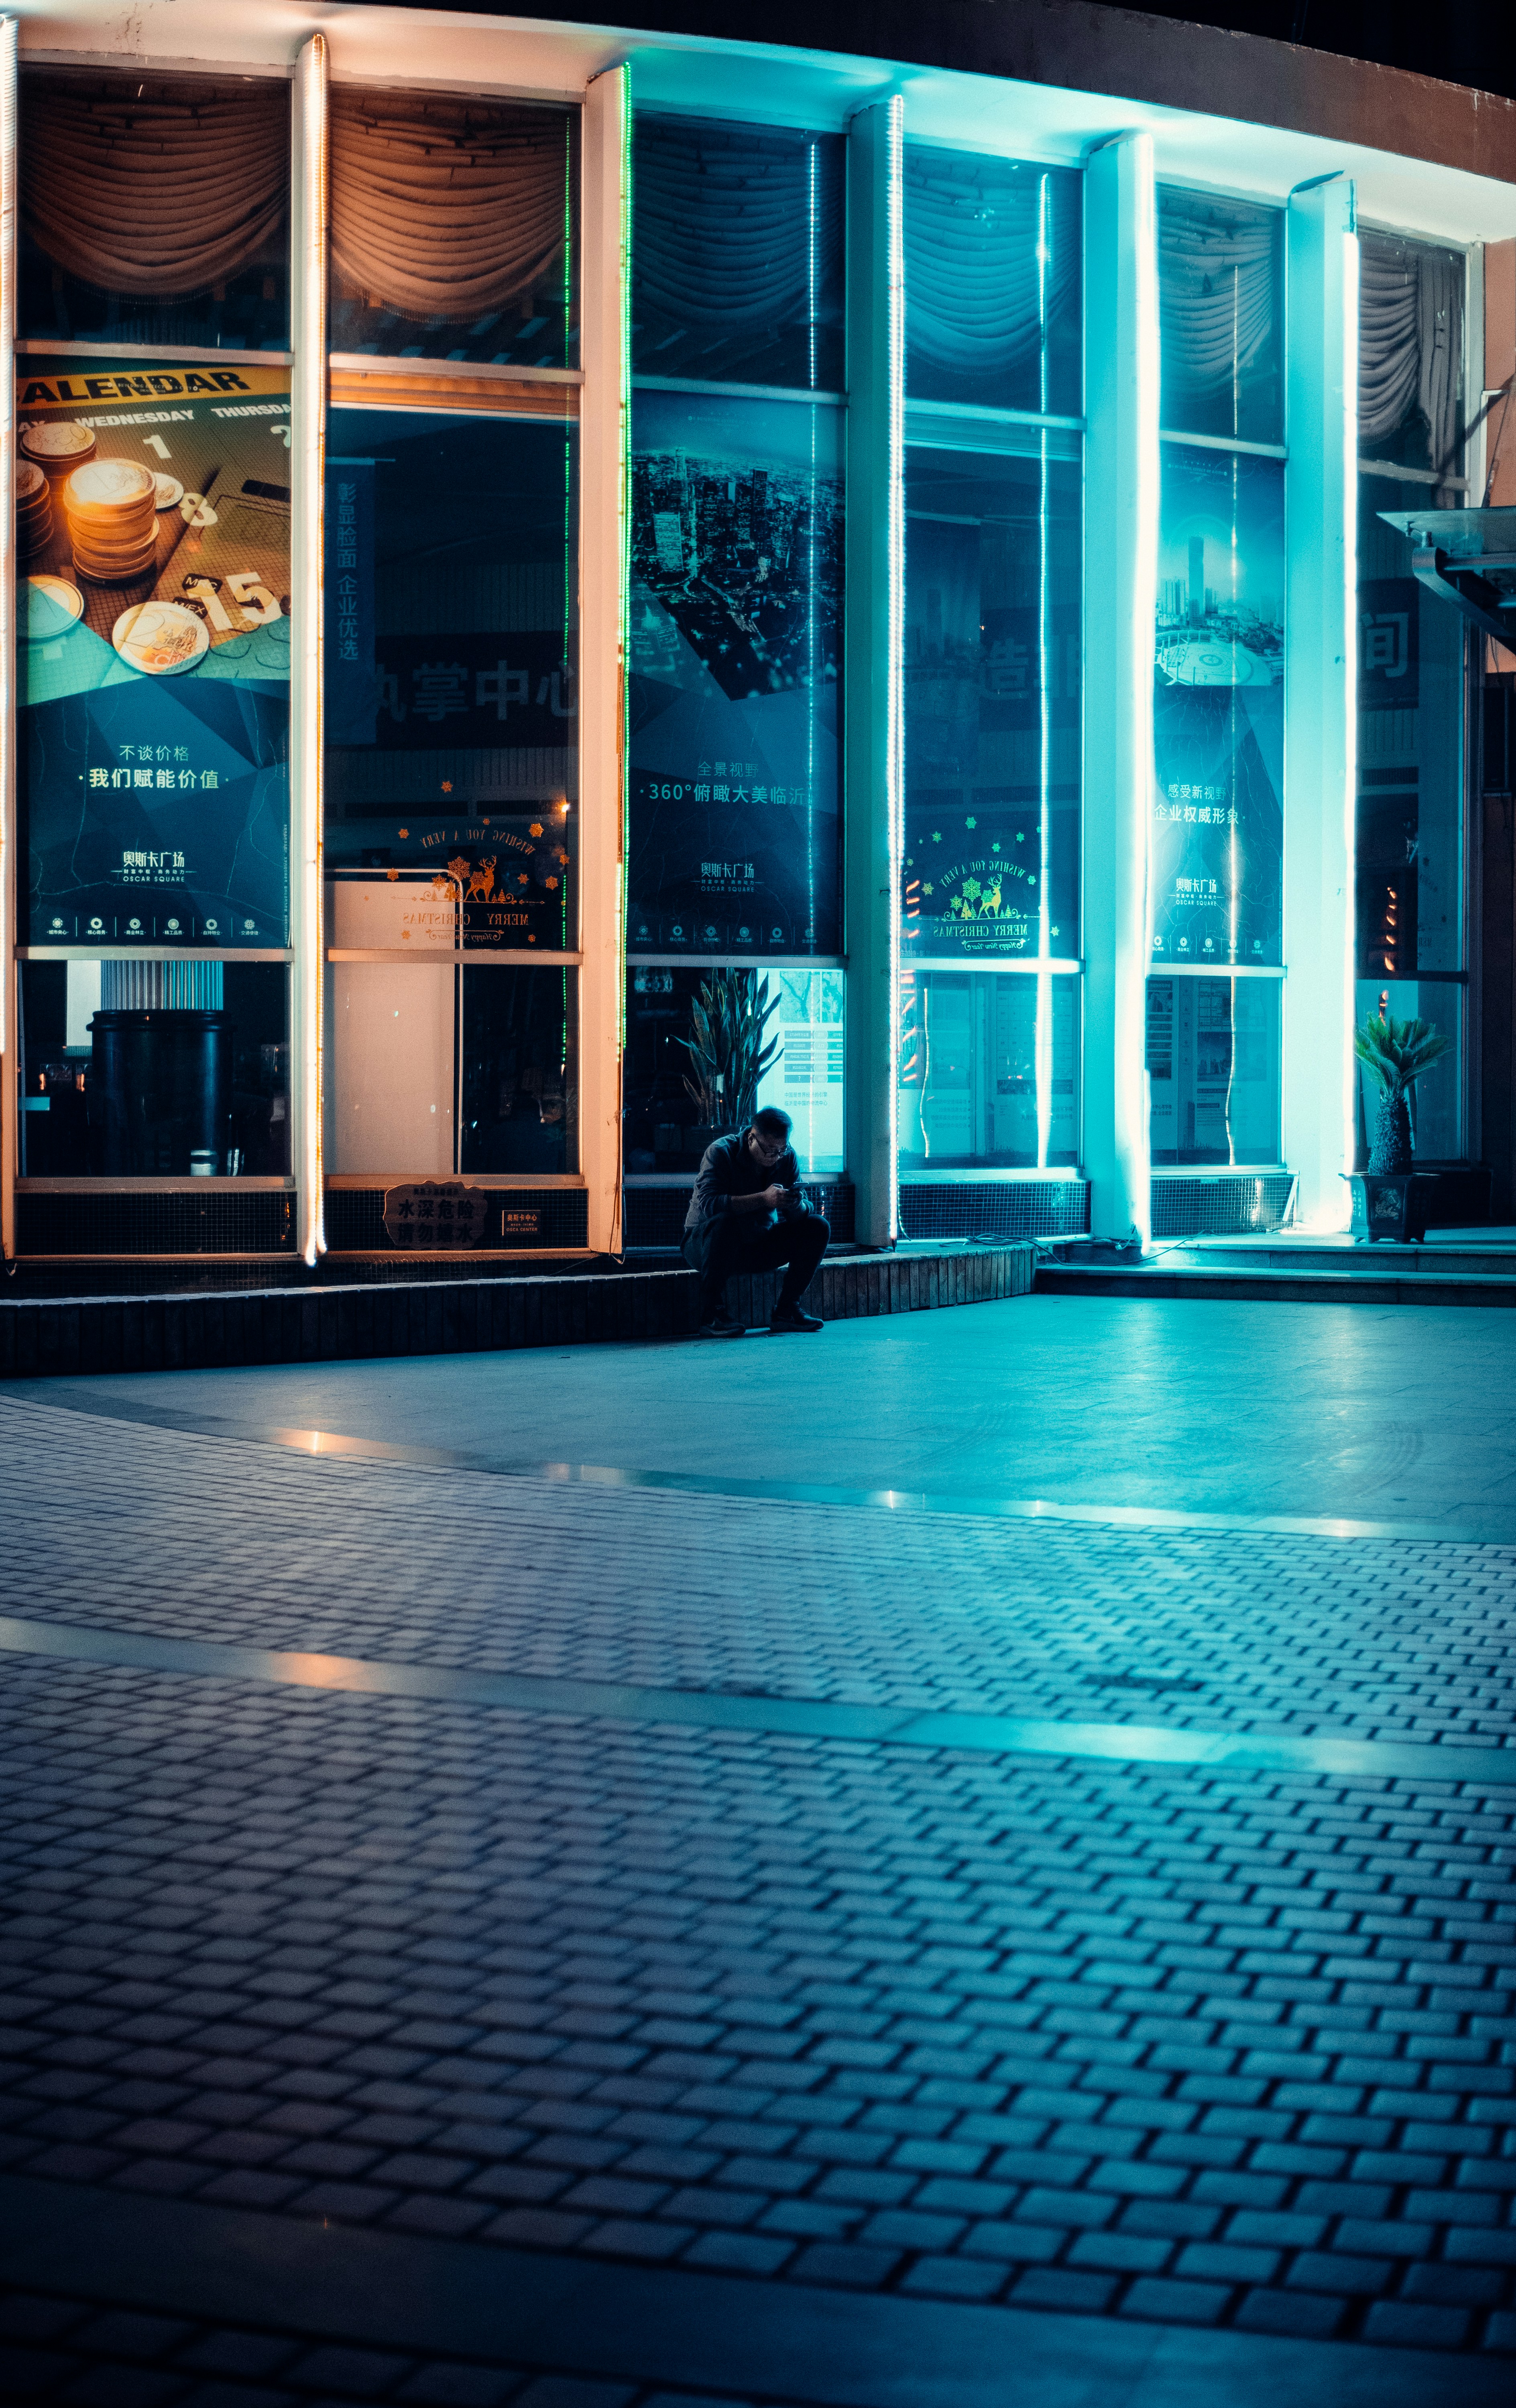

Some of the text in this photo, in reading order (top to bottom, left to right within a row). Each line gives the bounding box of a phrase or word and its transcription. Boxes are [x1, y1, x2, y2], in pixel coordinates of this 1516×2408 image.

[17, 372, 251, 404] ALENDAR
[75, 404, 291, 428] WEDNESDAY THURSDA
[142, 435, 172, 459] 1
[337, 575, 358, 661] 企业优选
[119, 745, 189, 762] 不谈价格
[89, 768, 220, 789] 我们赋能价值
[698, 761, 759, 778] 全景视野
[1168, 783, 1226, 801] 感受新视野
[1154, 803, 1239, 824] 企业权威形象
[123, 851, 185, 867] 奥斯卡广场
[701, 862, 754, 878] 奥斯卡广场
[1176, 877, 1217, 893] 奥斯卡广场
[398, 1199, 474, 1219] 水深危险
